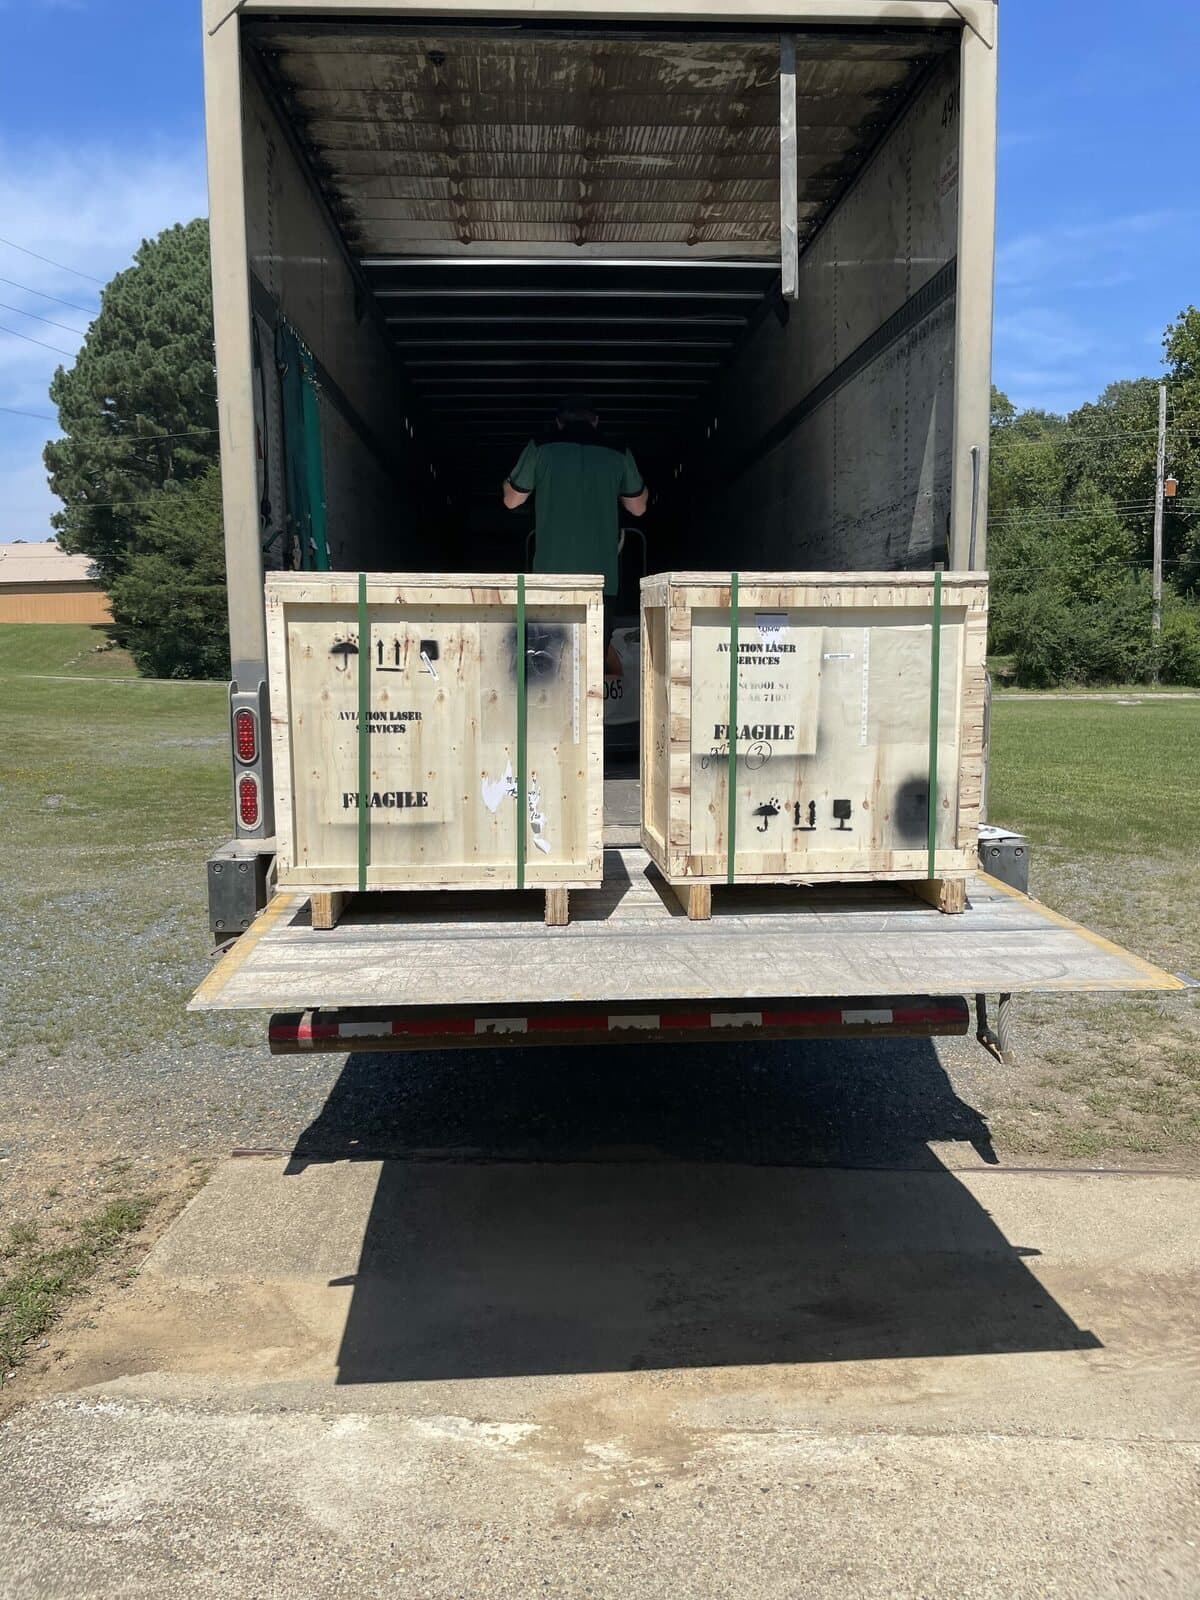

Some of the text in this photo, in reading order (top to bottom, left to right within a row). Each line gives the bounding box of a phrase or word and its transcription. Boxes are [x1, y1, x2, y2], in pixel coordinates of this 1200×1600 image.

[717, 643, 796, 653] AVTION LASER
[389, 711, 422, 721] LASER
[356, 724, 406, 734] SERVICES
[714, 724, 795, 740] FRAGILE
[342, 791, 429, 809] FRAGILE
